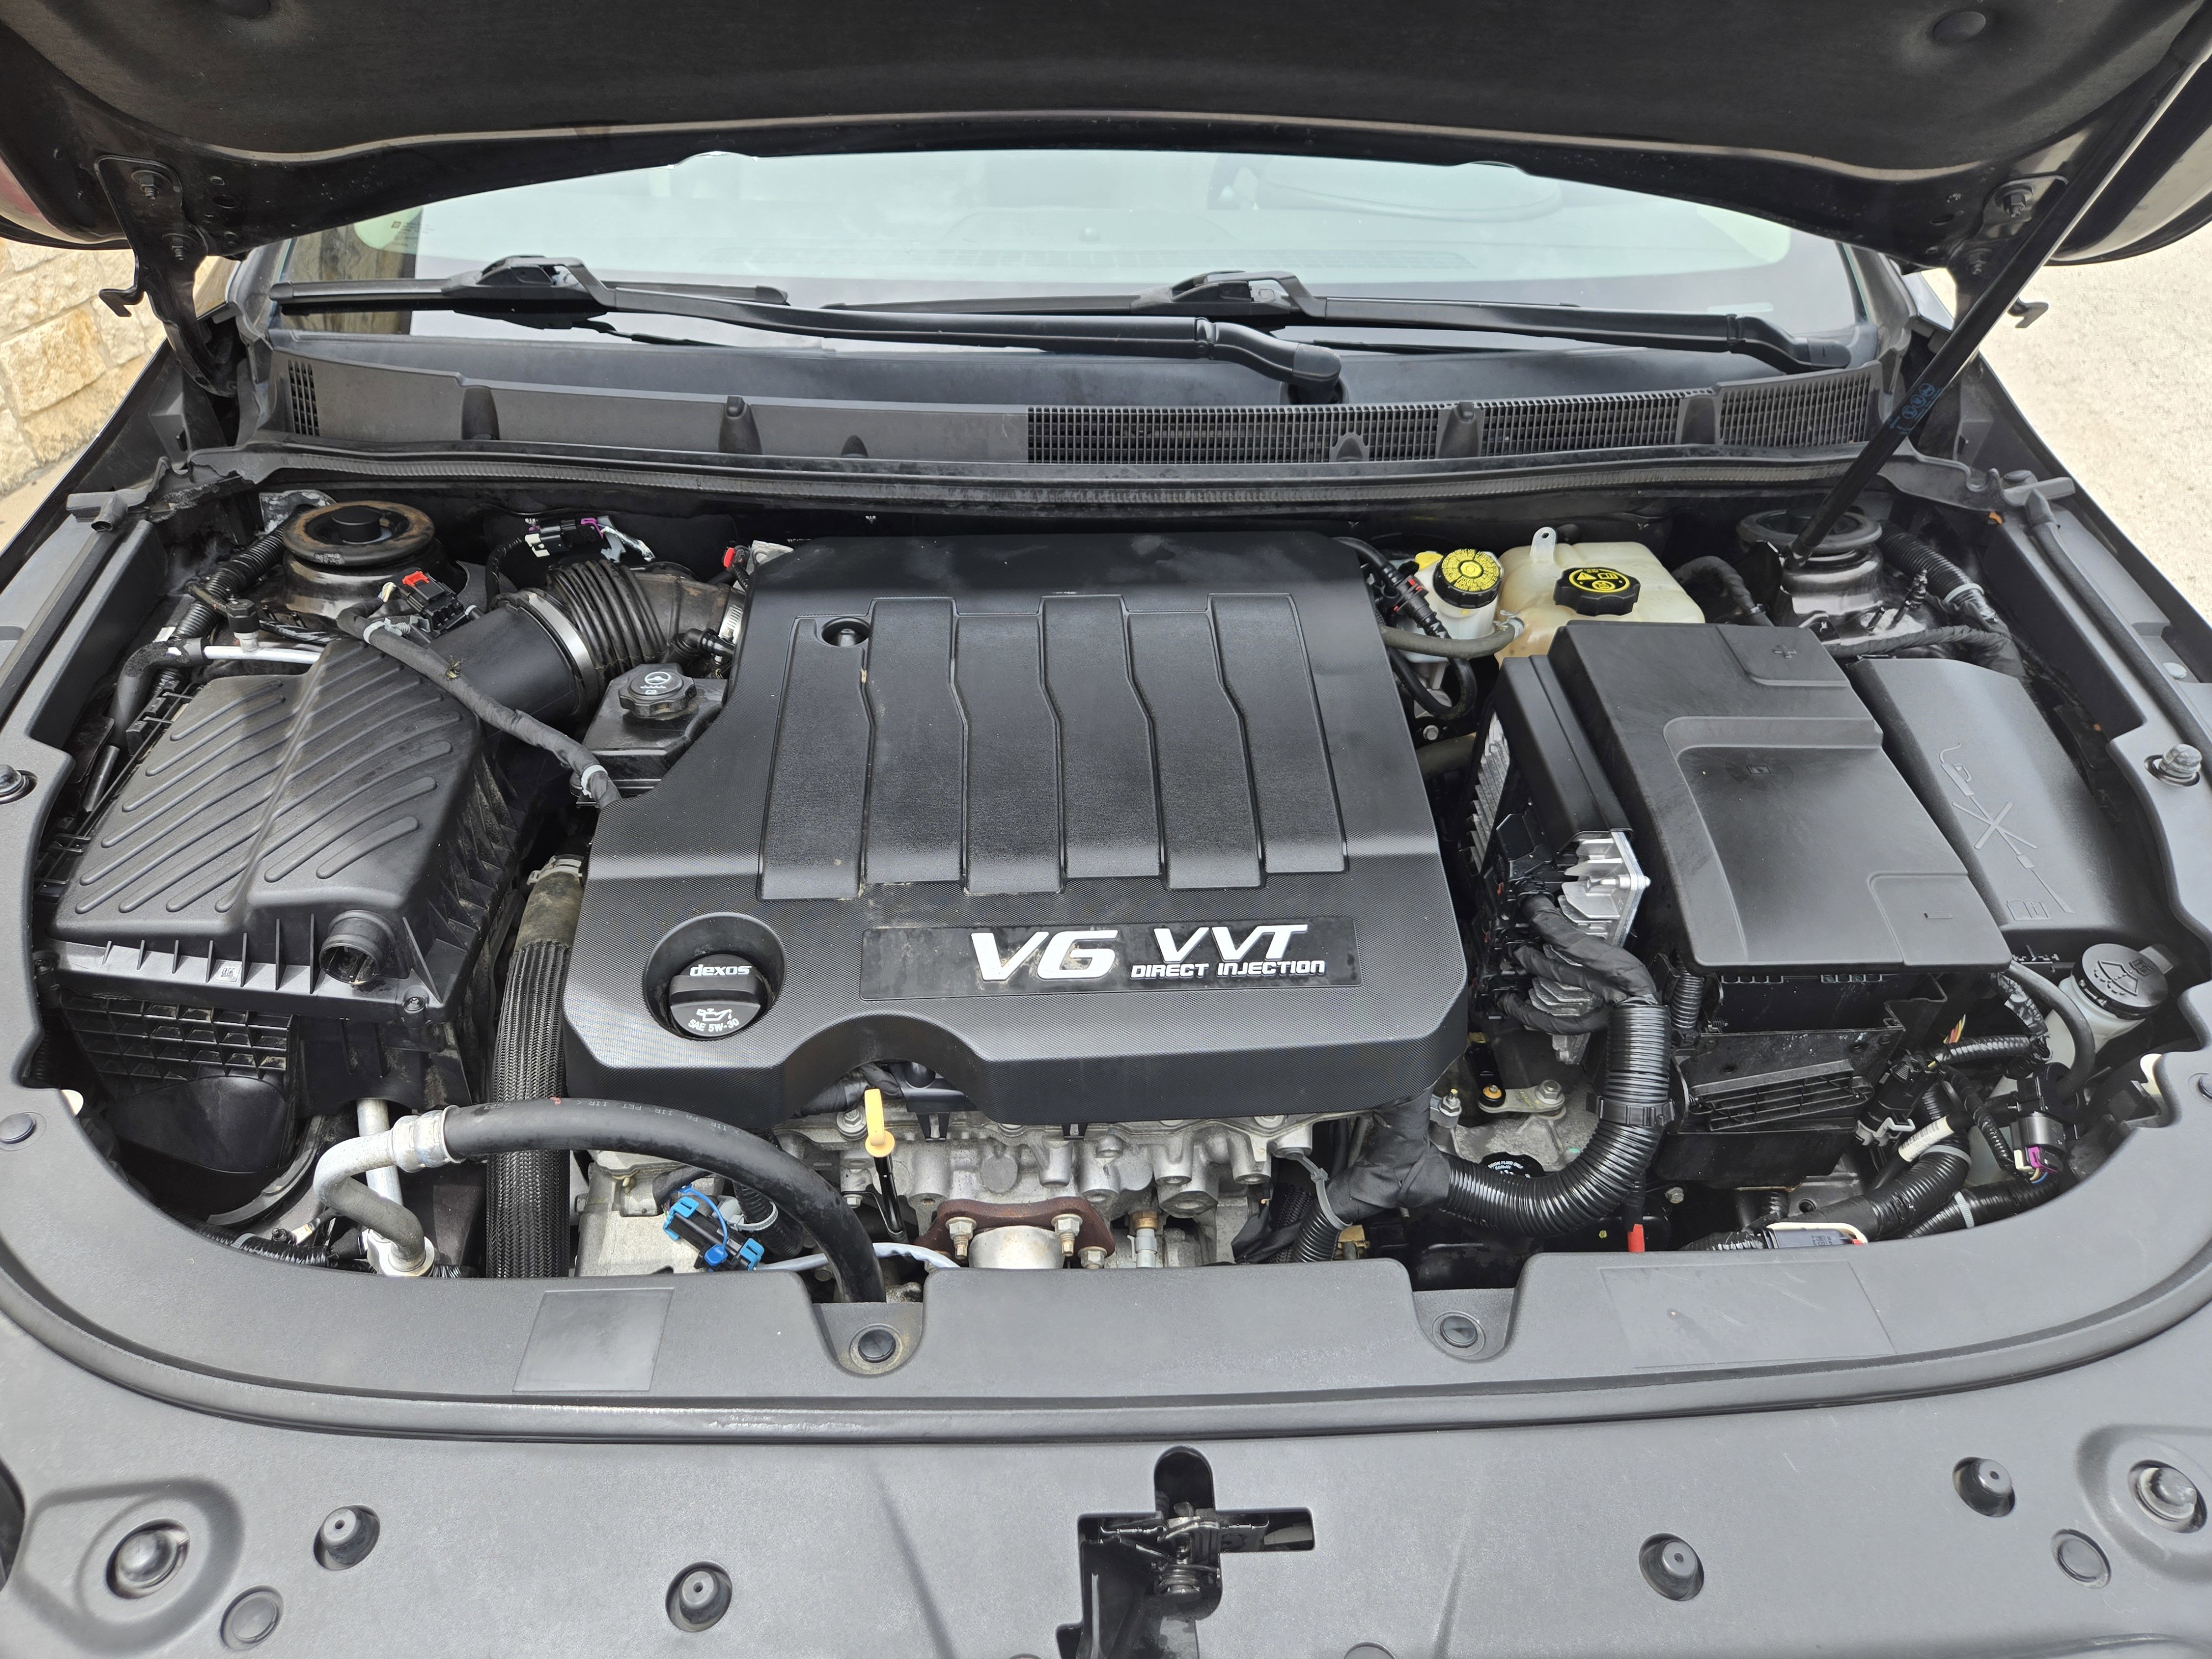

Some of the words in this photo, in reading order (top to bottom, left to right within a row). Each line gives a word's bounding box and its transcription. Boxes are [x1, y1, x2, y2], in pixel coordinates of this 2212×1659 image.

[971, 930, 1118, 982] V6
[1154, 924, 1308, 962] VVT
[690, 964, 752, 977] dexos
[1131, 963, 1209, 979] DIRECT
[1217, 960, 1326, 977] INJECTION
[688, 1019, 707, 1031] SAE
[708, 1018, 740, 1032] 5W-30
[620, 1103, 642, 1111] PET
[654, 1107, 673, 1117] IIR
[686, 1114, 698, 1123] PA
